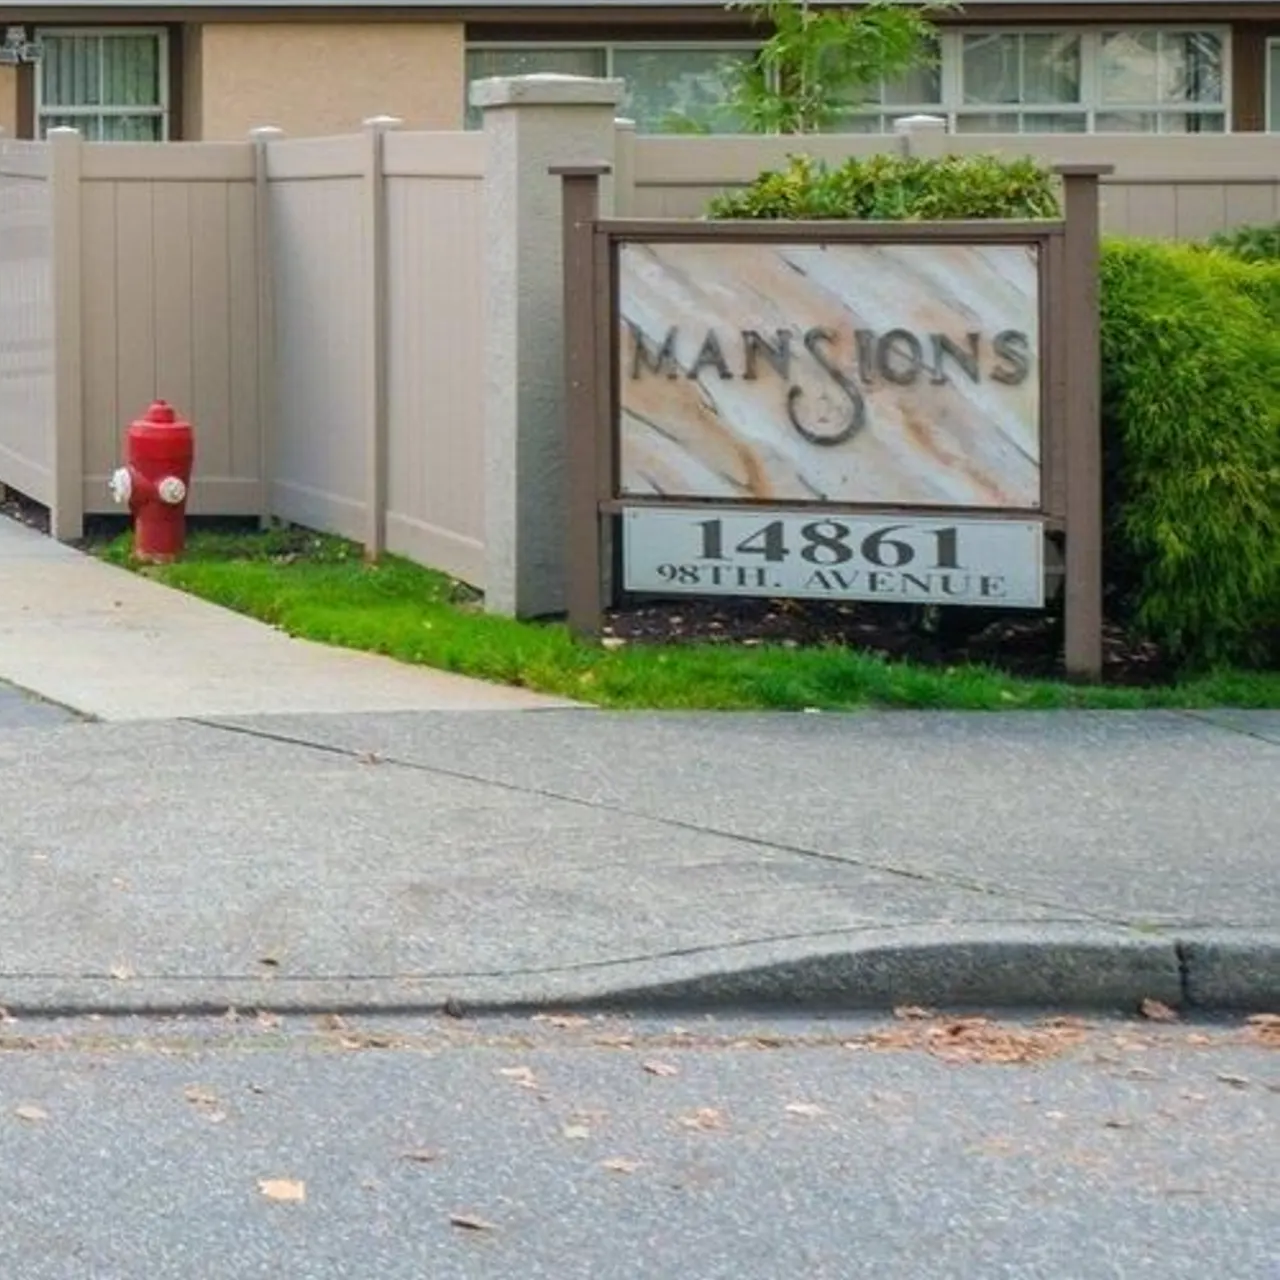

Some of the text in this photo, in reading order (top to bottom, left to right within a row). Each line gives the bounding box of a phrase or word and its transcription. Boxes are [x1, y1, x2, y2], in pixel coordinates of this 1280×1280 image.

[628, 325, 1031, 447] MANSIONS
[693, 518, 964, 570] 14861
[655, 563, 1008, 598] 98TH. AVENUE
